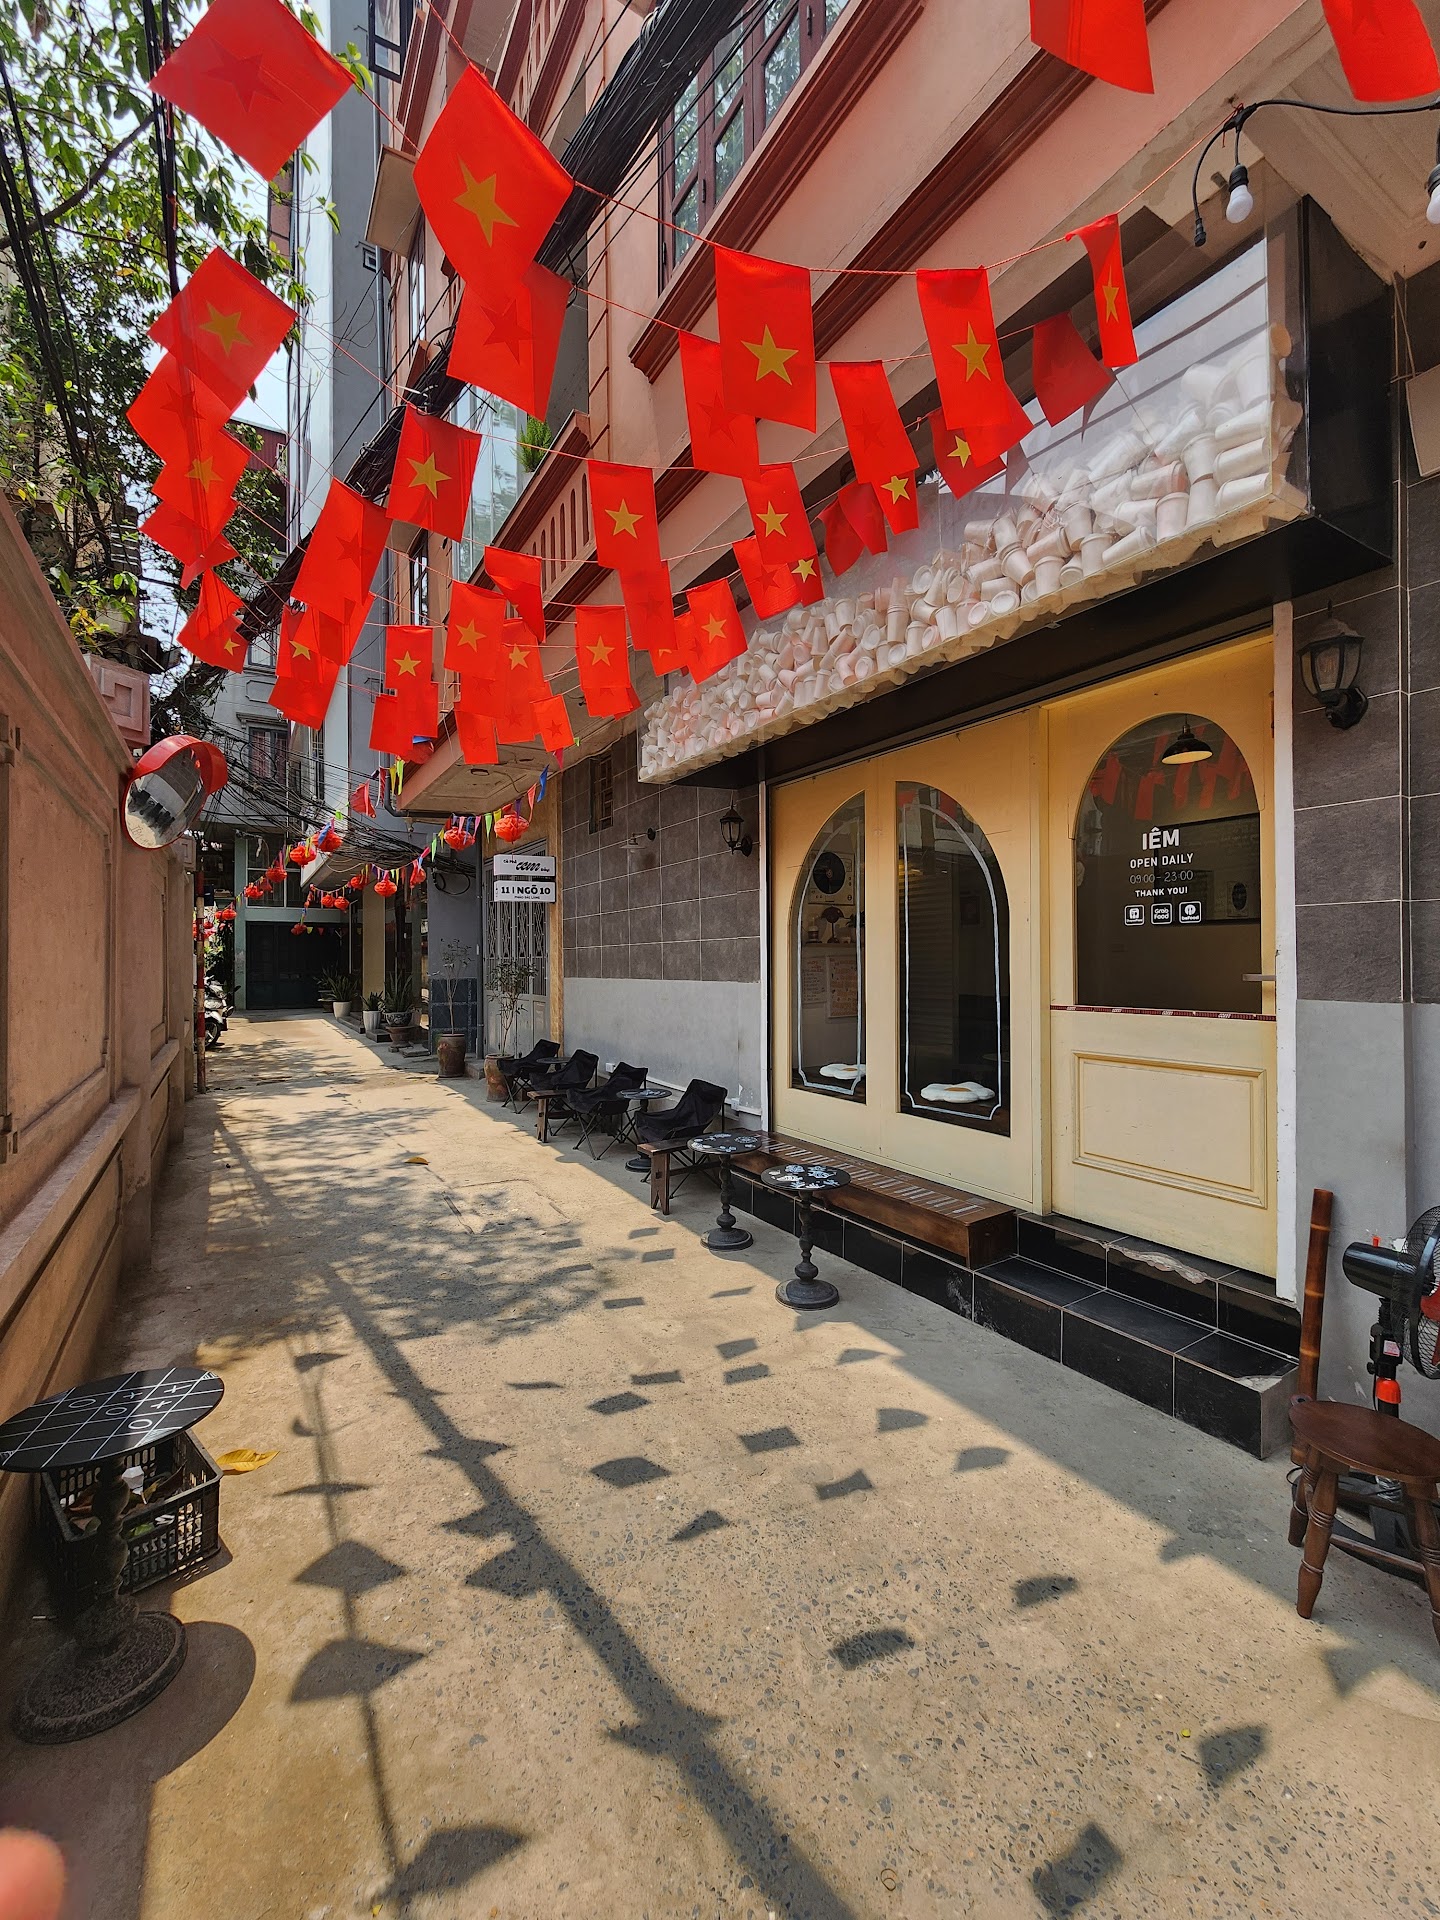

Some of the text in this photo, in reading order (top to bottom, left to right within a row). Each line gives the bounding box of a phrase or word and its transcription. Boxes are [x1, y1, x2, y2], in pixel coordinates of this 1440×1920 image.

[1142, 826, 1180, 850] IÊM
[1130, 853, 1194, 869] OPEN DAILY
[1129, 873, 1155, 885] 09:00
[1164, 870, 1194, 883] 23:00
[540, 887, 551, 895] 10
[1135, 886, 1188, 897] THANK YOU!
